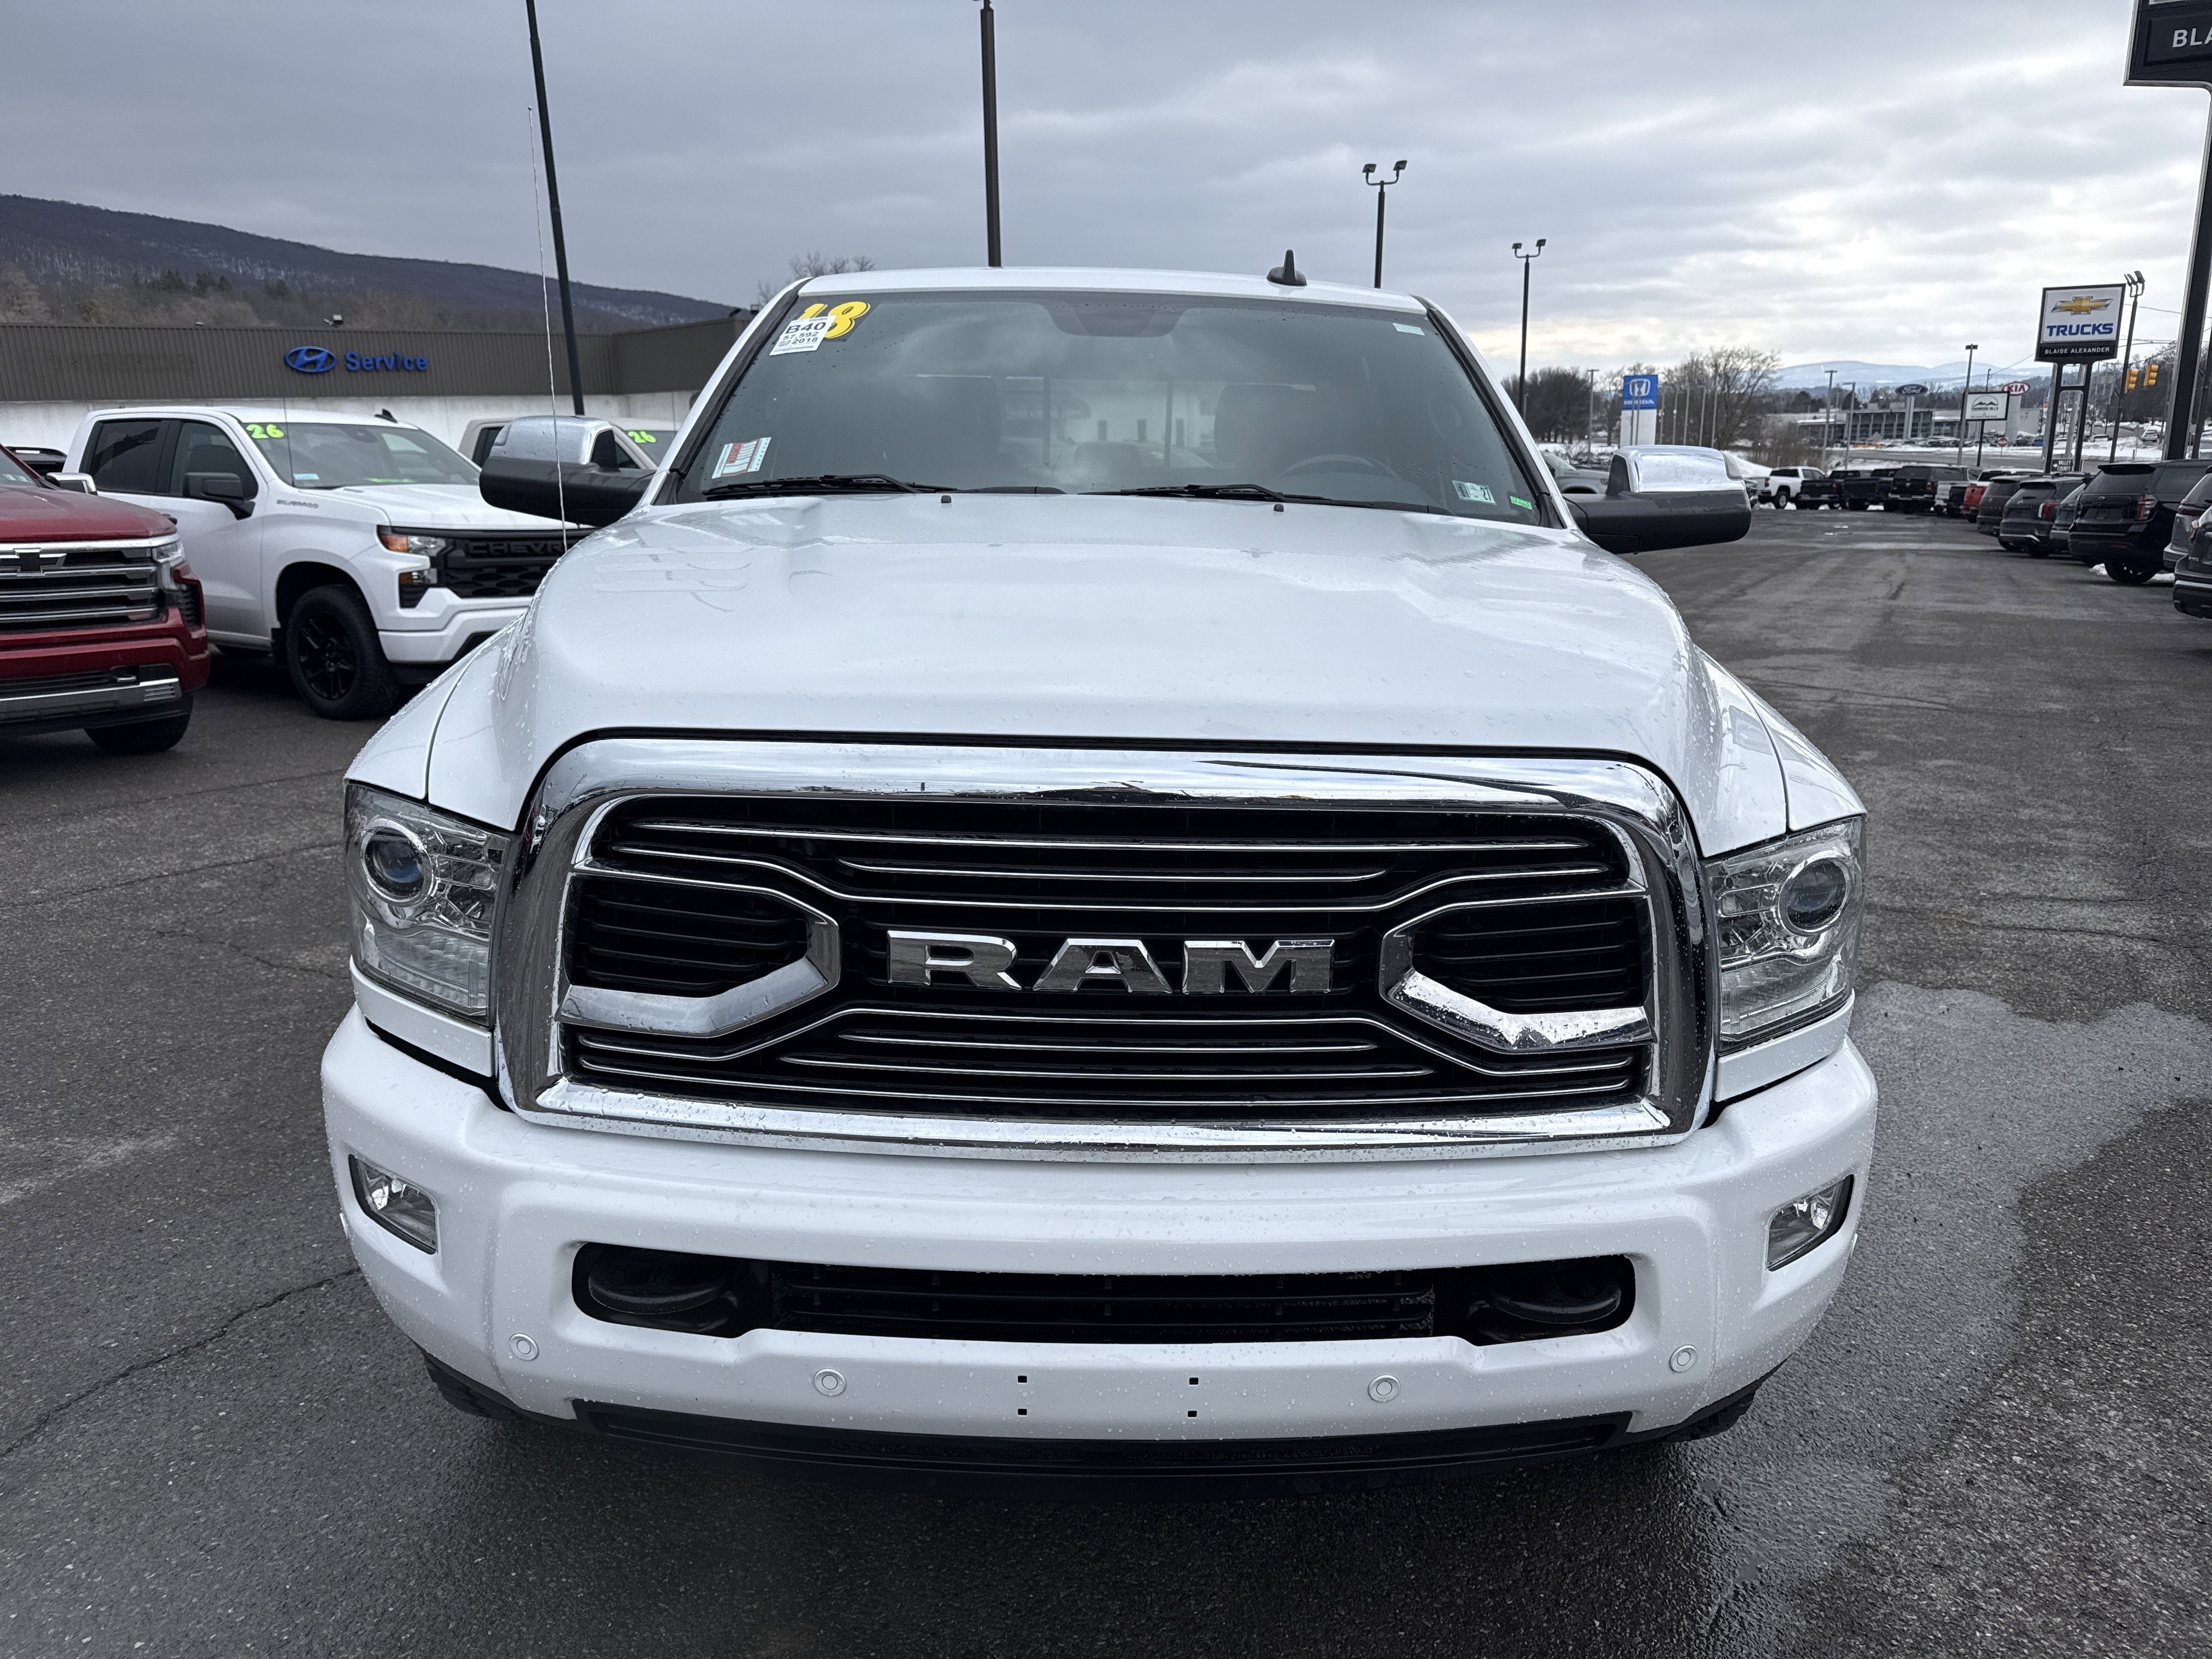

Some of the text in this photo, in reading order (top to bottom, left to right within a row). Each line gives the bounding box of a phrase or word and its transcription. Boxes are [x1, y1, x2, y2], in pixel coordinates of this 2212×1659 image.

[785, 322, 826, 334] B40
[2046, 323, 2114, 337] TRUCKS
[783, 331, 819, 340] 57,592
[345, 351, 428, 371] Service
[2007, 385, 2026, 393] KIA
[246, 424, 284, 439] 26
[628, 431, 656, 443] 26
[887, 930, 1336, 994] RAM
